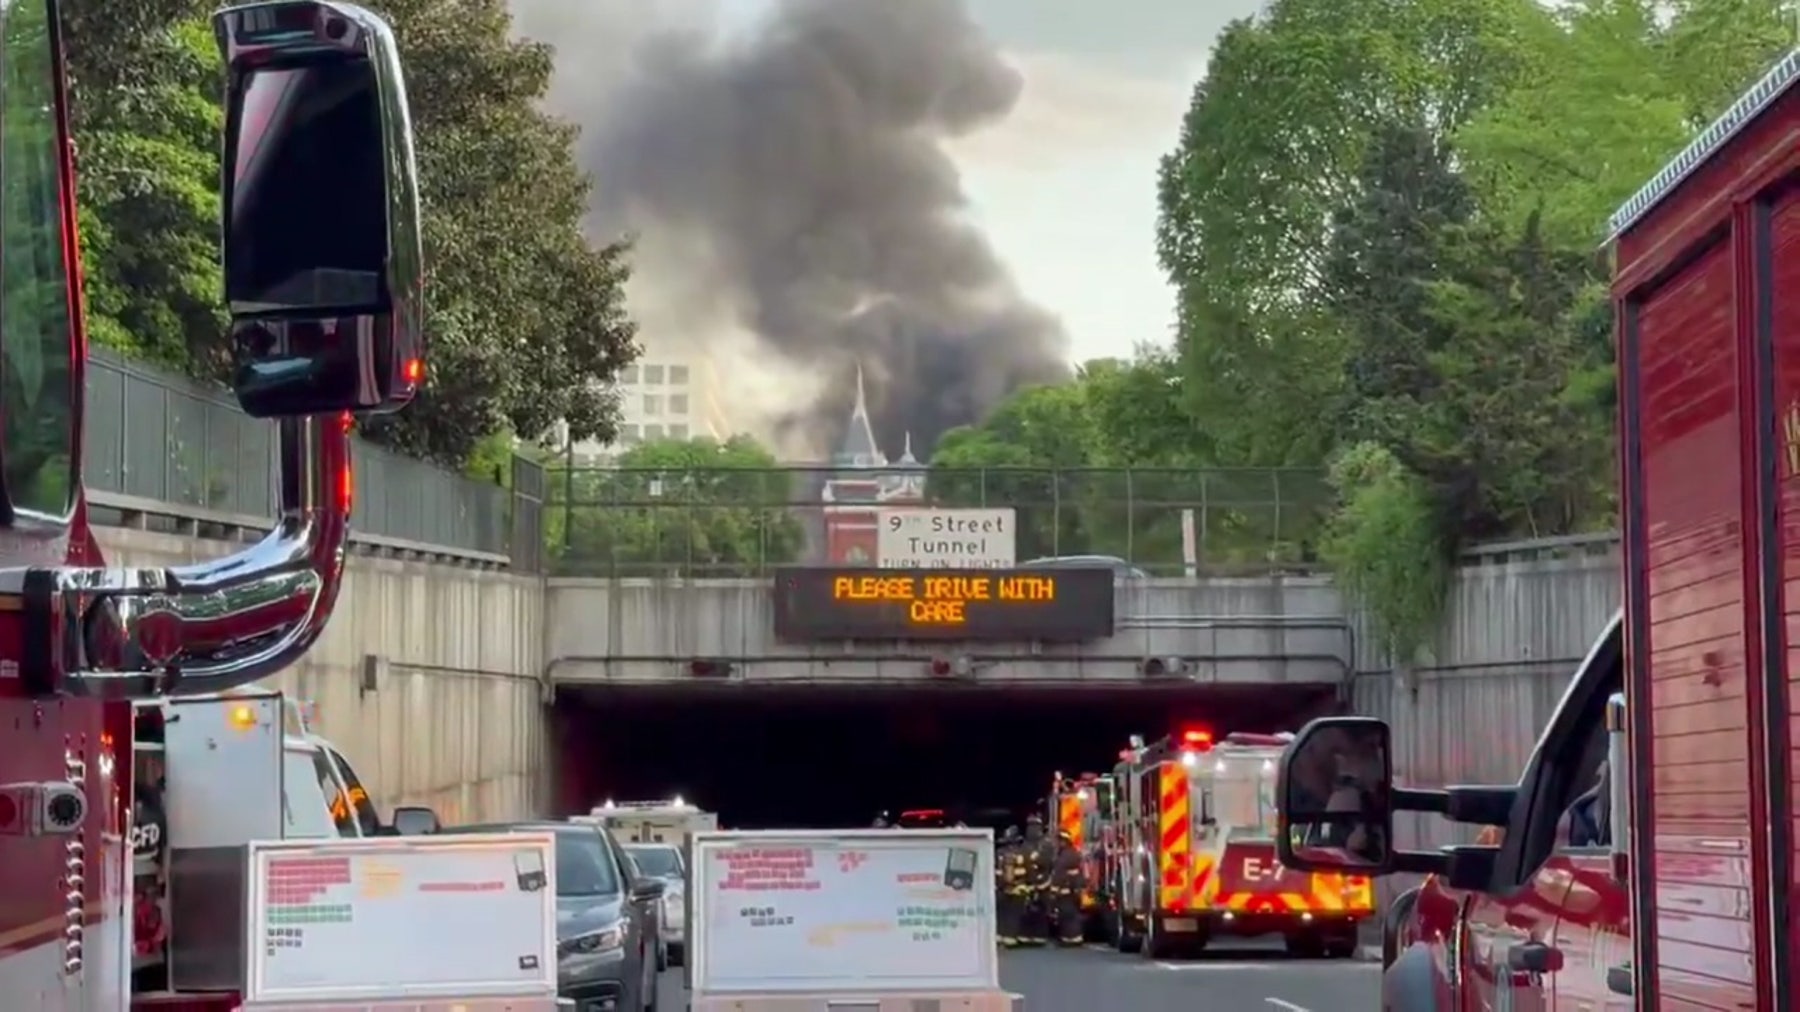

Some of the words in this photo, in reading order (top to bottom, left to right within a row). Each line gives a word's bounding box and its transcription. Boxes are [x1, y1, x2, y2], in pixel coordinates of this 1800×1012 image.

[931, 516, 1003, 533] Street
[908, 537, 985, 555] Tunnel
[835, 577, 914, 598] PLEASE
[925, 577, 990, 598] DRIVE
[999, 577, 1053, 599] WITH
[910, 600, 965, 621] CARE
